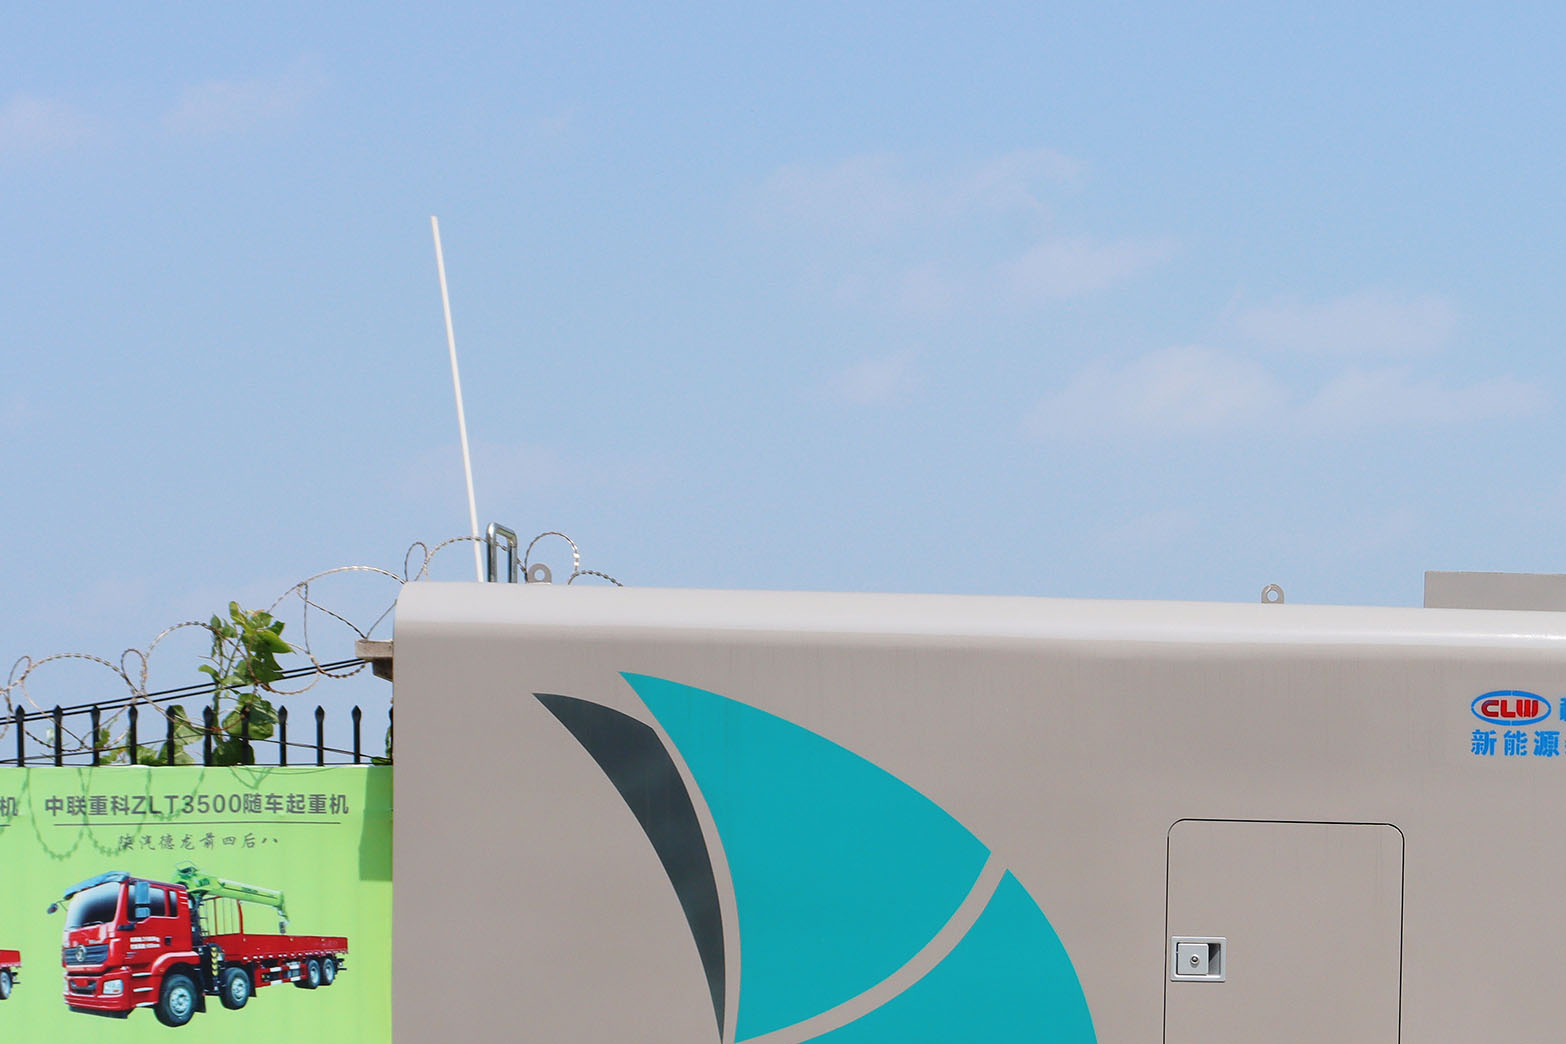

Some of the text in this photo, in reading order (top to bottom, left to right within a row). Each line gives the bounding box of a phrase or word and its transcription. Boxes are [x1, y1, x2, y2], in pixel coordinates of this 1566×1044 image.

[1481, 699, 1539, 718] CLW
[45, 794, 348, 817] 中联重科ZLT3500随车起重机
